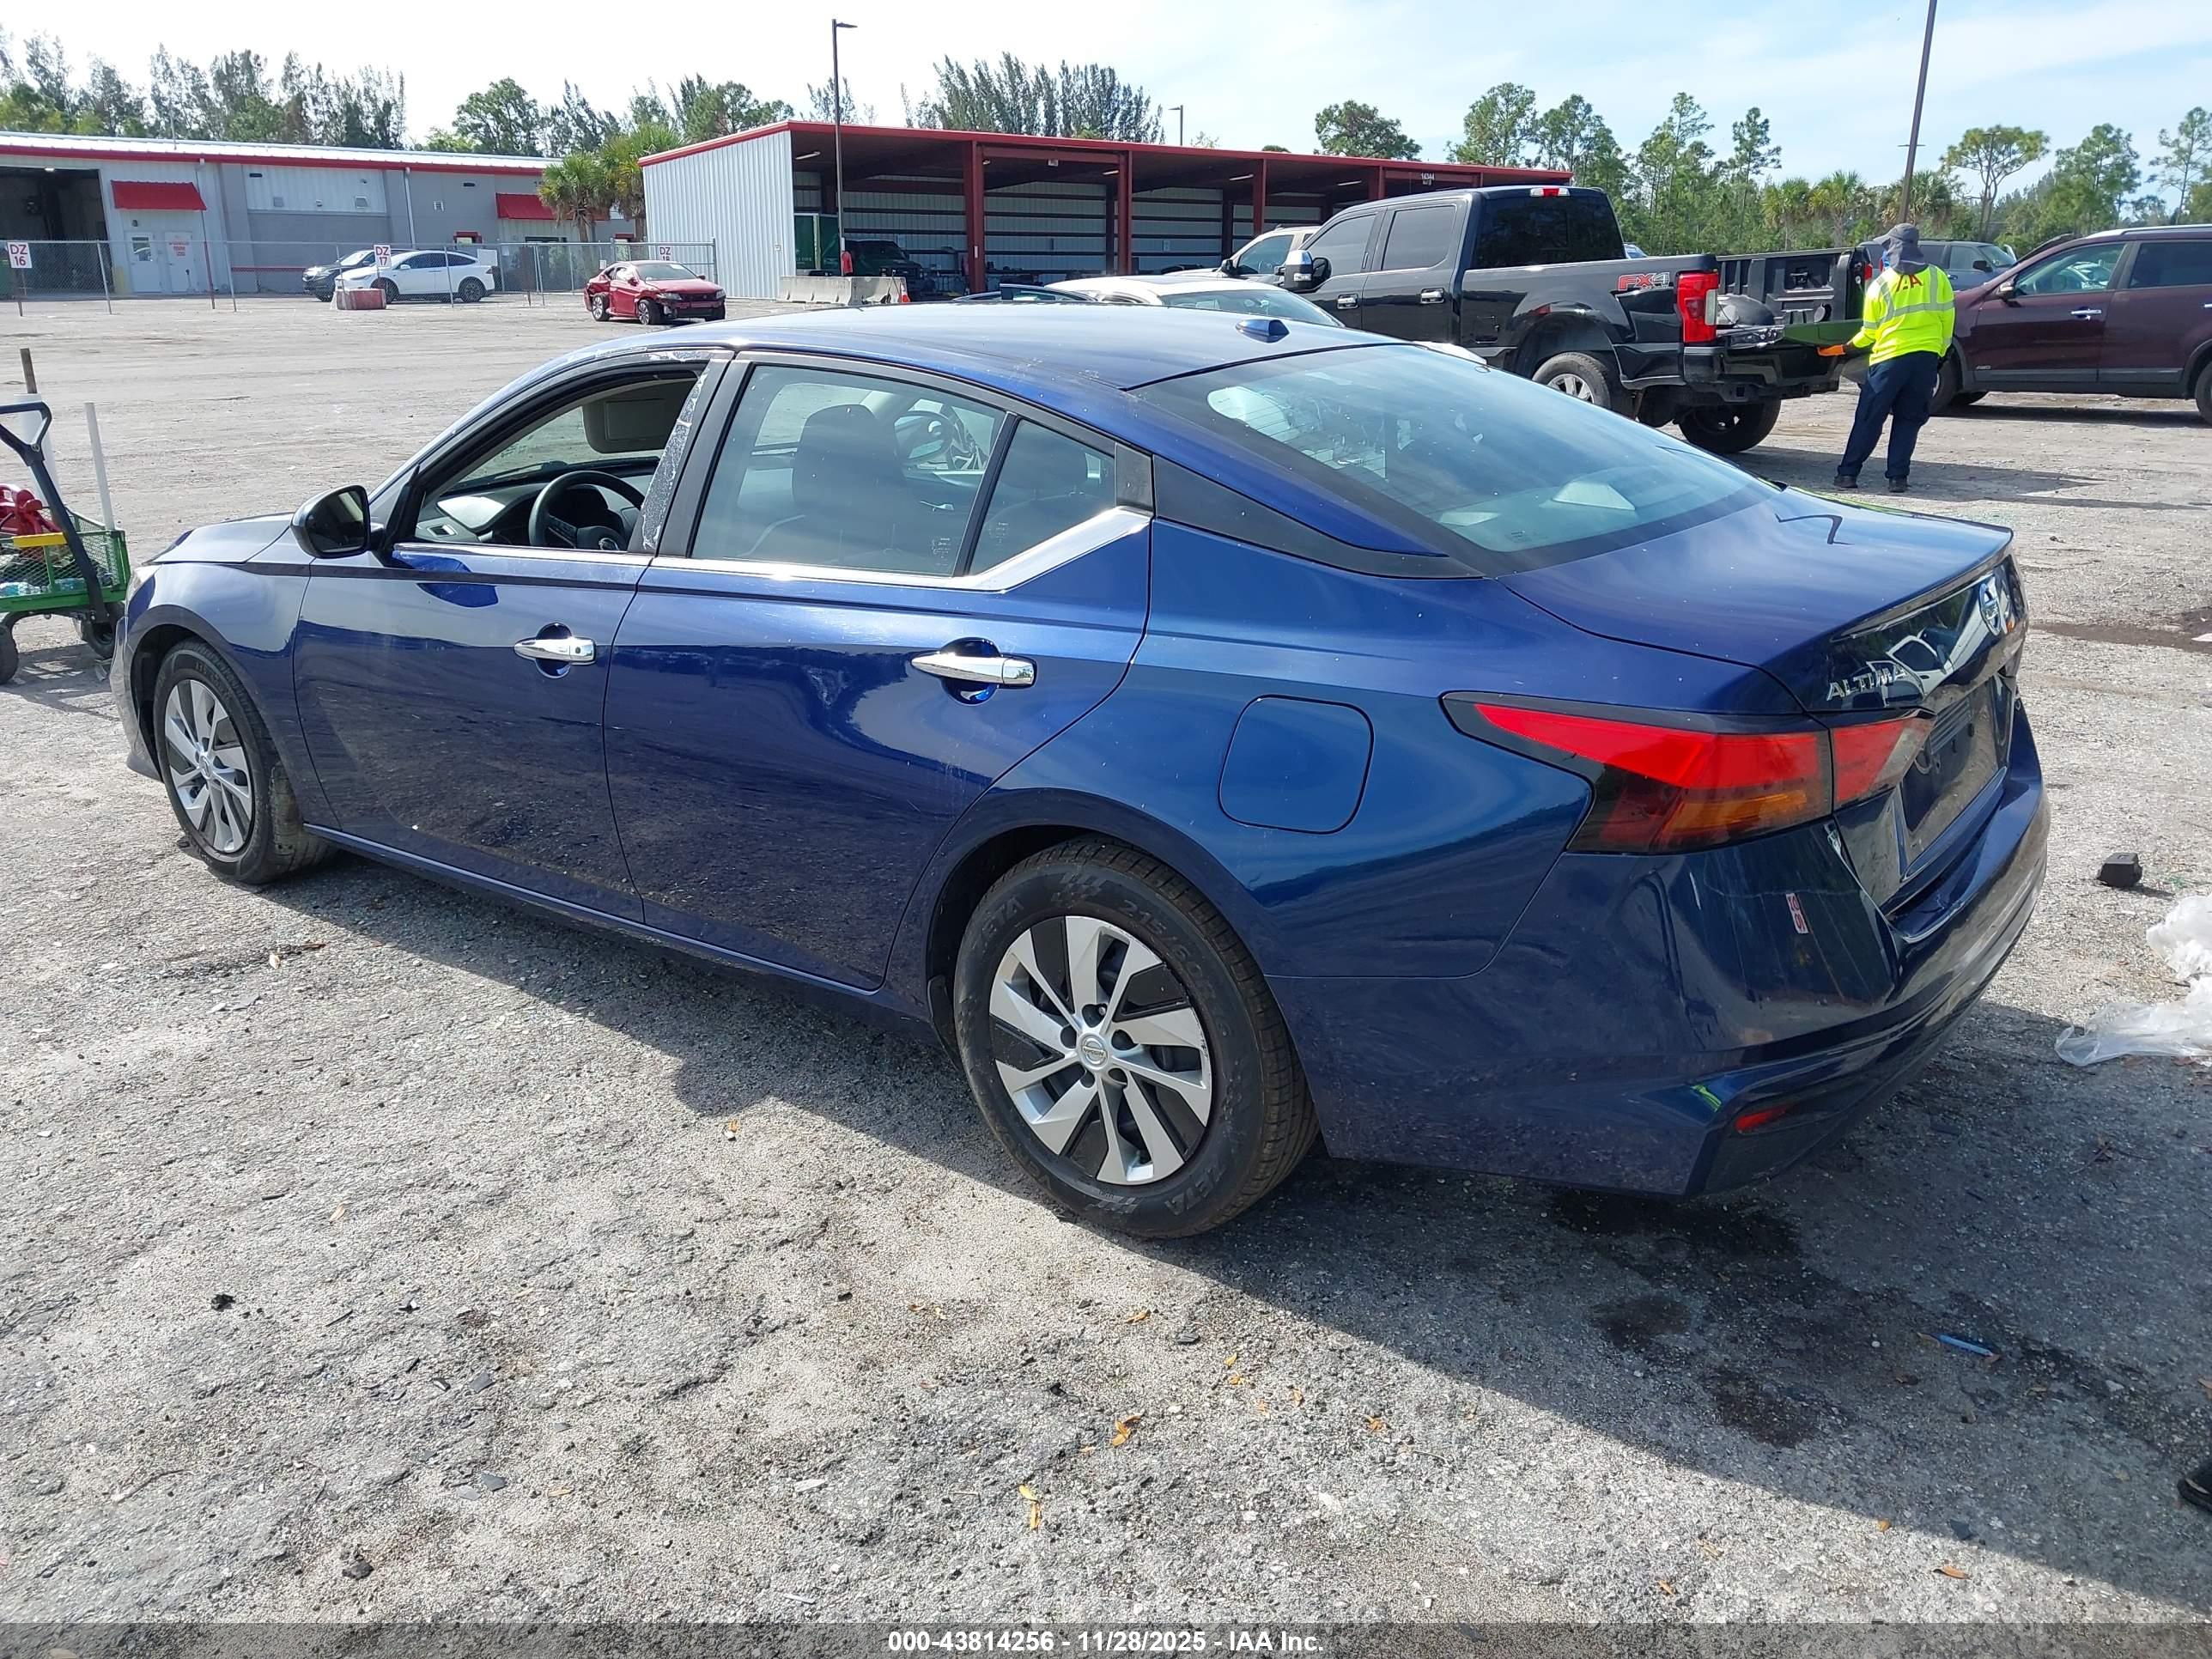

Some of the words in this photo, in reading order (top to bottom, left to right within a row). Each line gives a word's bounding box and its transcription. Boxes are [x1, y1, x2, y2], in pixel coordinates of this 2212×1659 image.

[9, 244, 28, 255] DZ
[375, 246, 390, 256] DZ
[659, 246, 672, 256] DZ
[14, 256, 27, 266] 16
[379, 257, 388, 266] 17
[1618, 272, 1670, 291] FX4
[1826, 664, 1907, 702] ALTIMA
